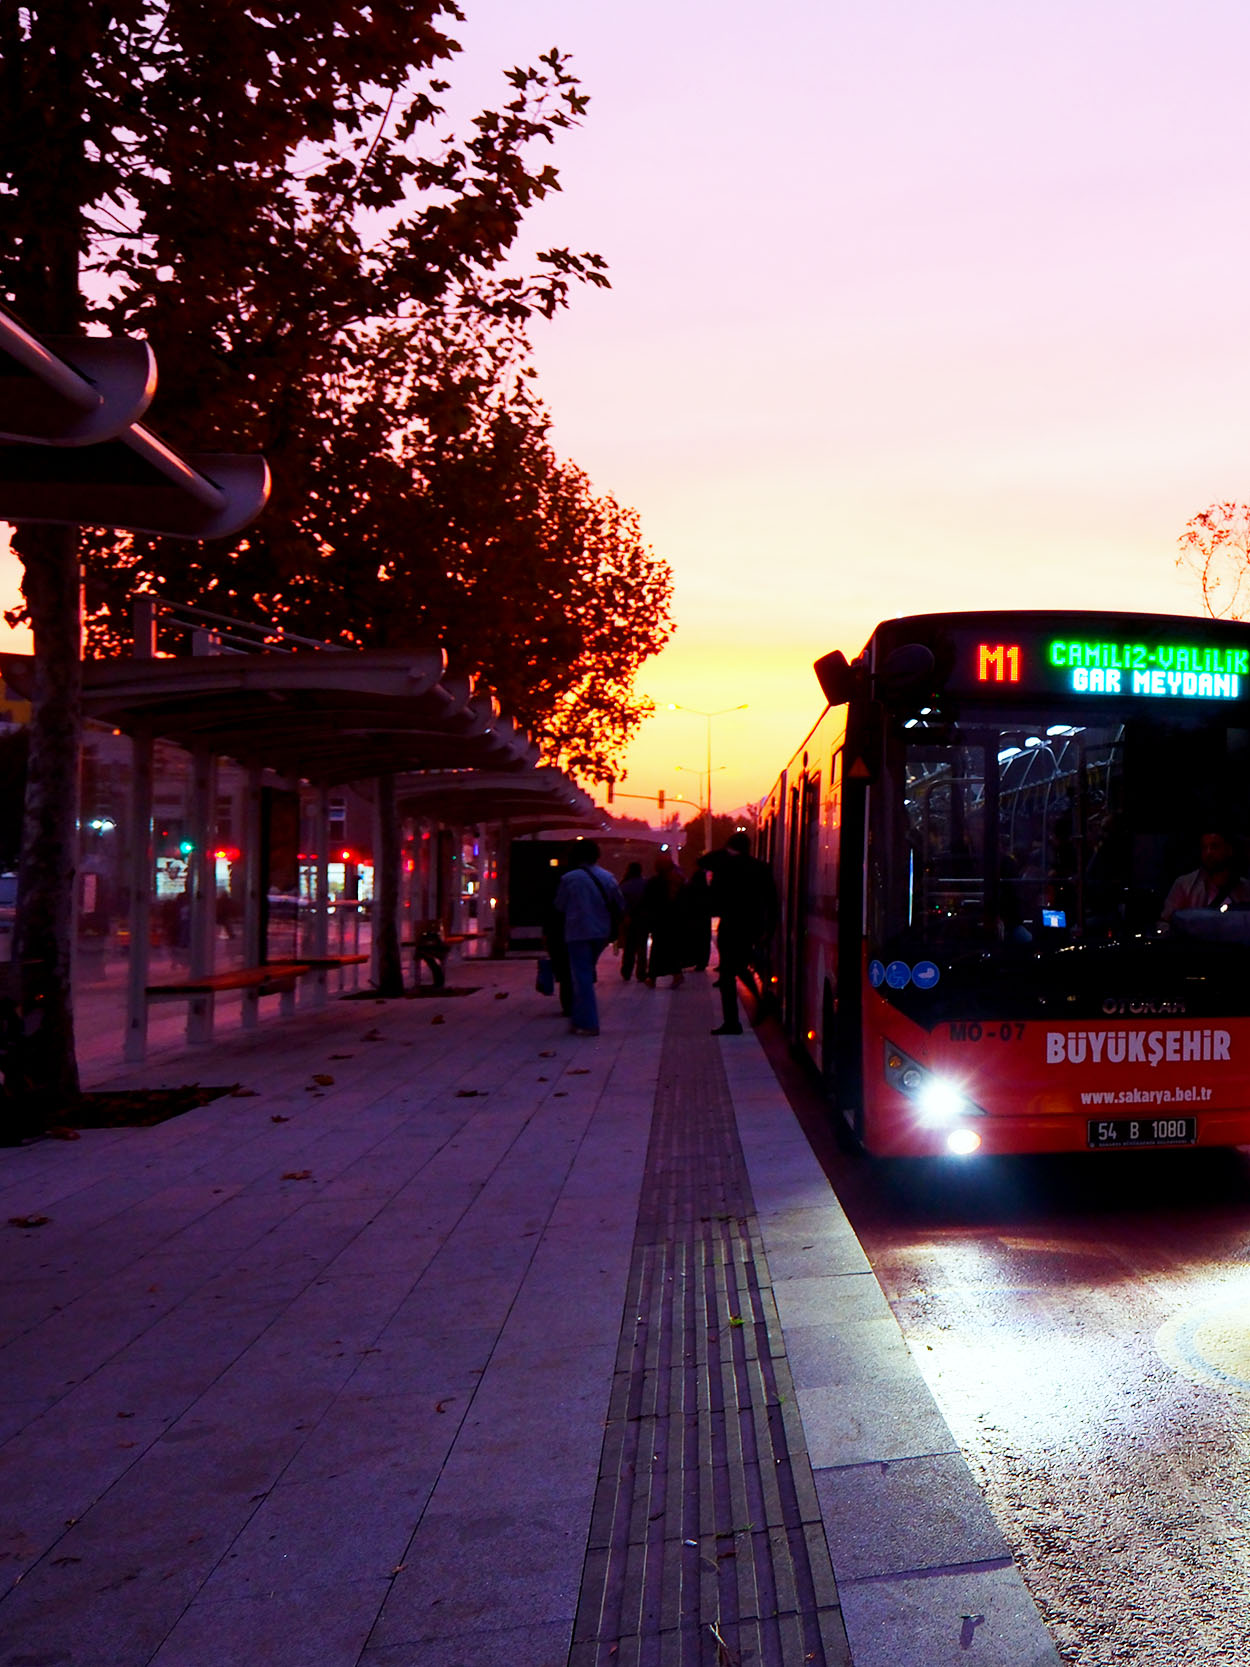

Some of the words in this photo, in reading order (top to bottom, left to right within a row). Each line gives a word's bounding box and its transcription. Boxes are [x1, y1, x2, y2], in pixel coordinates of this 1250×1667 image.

[978, 644, 1020, 682] M1
[1073, 667, 1121, 693] GAR
[1132, 669, 1239, 698] MEYDANI
[1046, 1030, 1232, 1067] BÜYÜKŞEHİR
[1080, 1086, 1213, 1105] www.sakarya.bel.tr
[1097, 1122, 1118, 1141] 54
[1129, 1121, 1140, 1139] B
[1151, 1119, 1187, 1138] 1080
